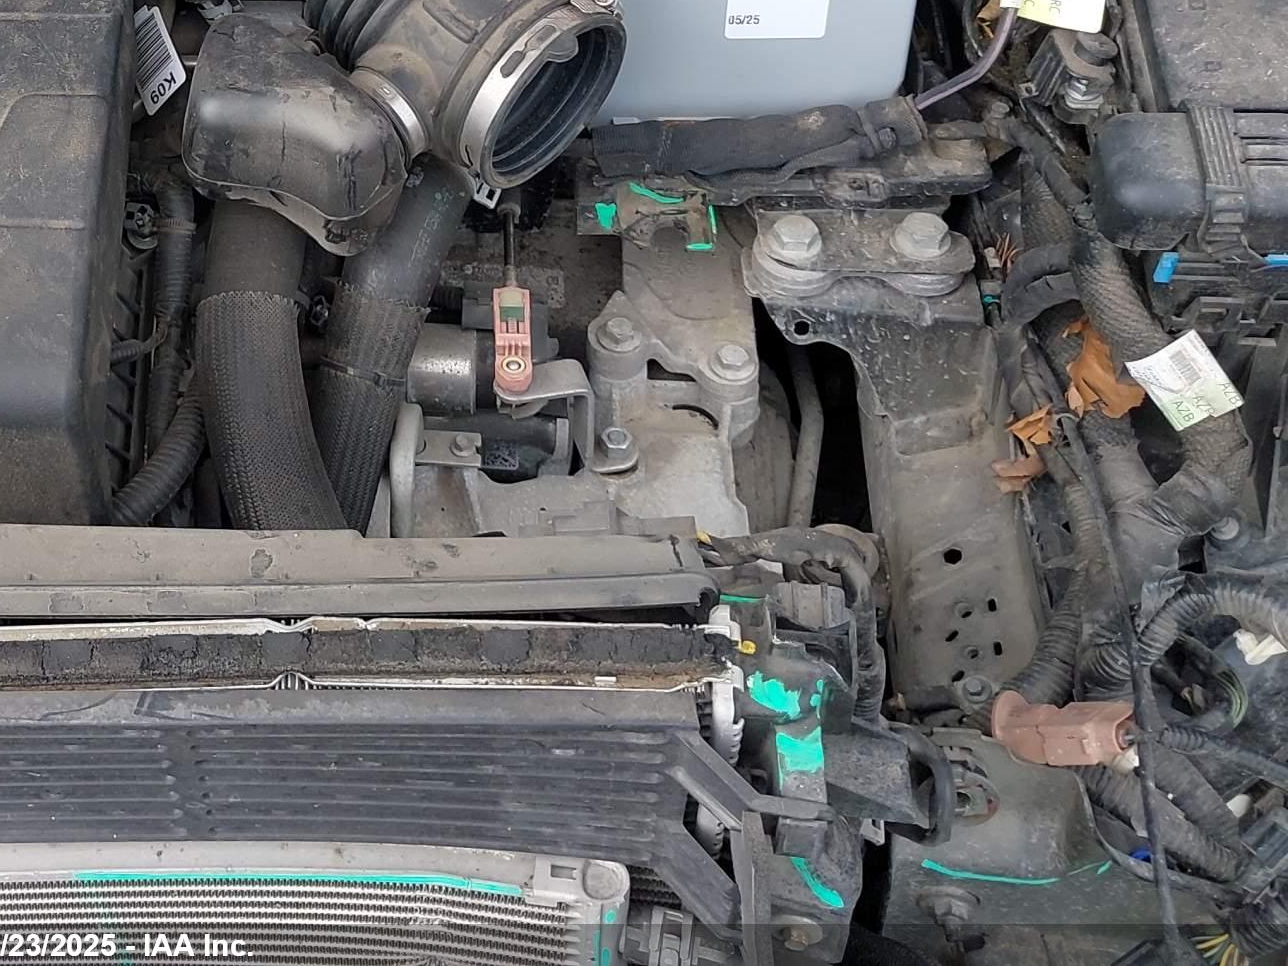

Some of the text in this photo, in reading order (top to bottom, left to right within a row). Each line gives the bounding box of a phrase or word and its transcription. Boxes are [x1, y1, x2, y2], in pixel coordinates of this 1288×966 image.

[728, 15, 760, 25] 05/25
[150, 72, 177, 105] K09
[1172, 400, 1196, 423] AZB
